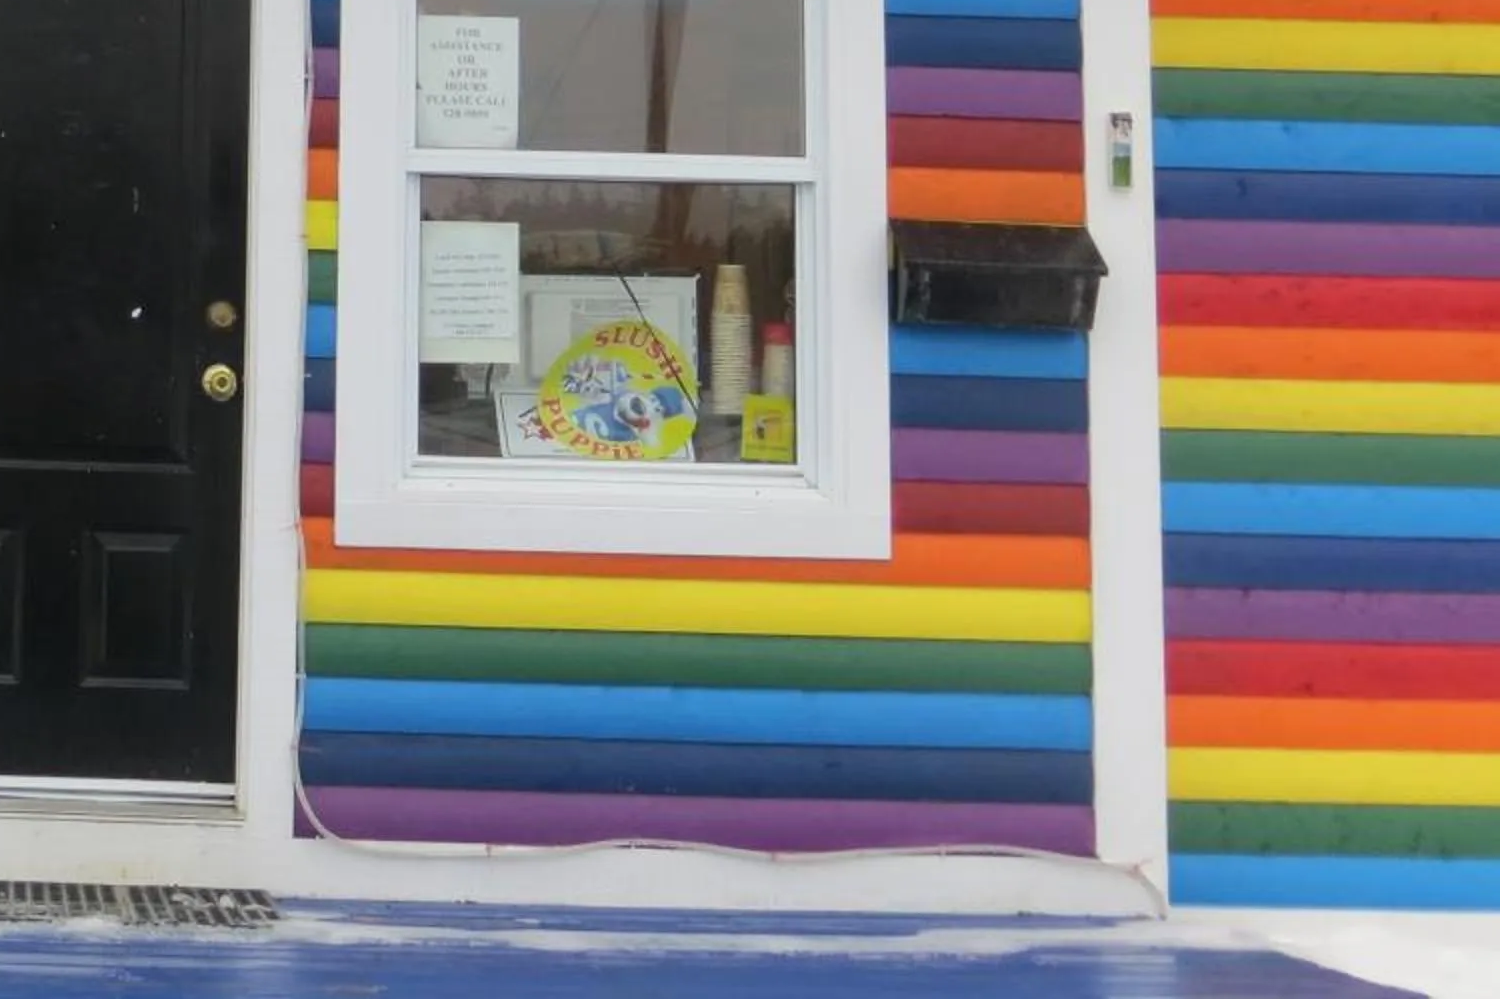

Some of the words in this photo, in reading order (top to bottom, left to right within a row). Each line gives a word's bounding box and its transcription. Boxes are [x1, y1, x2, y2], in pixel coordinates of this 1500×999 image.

[448, 68, 489, 79] AFTER
[444, 81, 489, 92] HOURS
[425, 94, 473, 106] PLEASE
[475, 95, 506, 108] CALL
